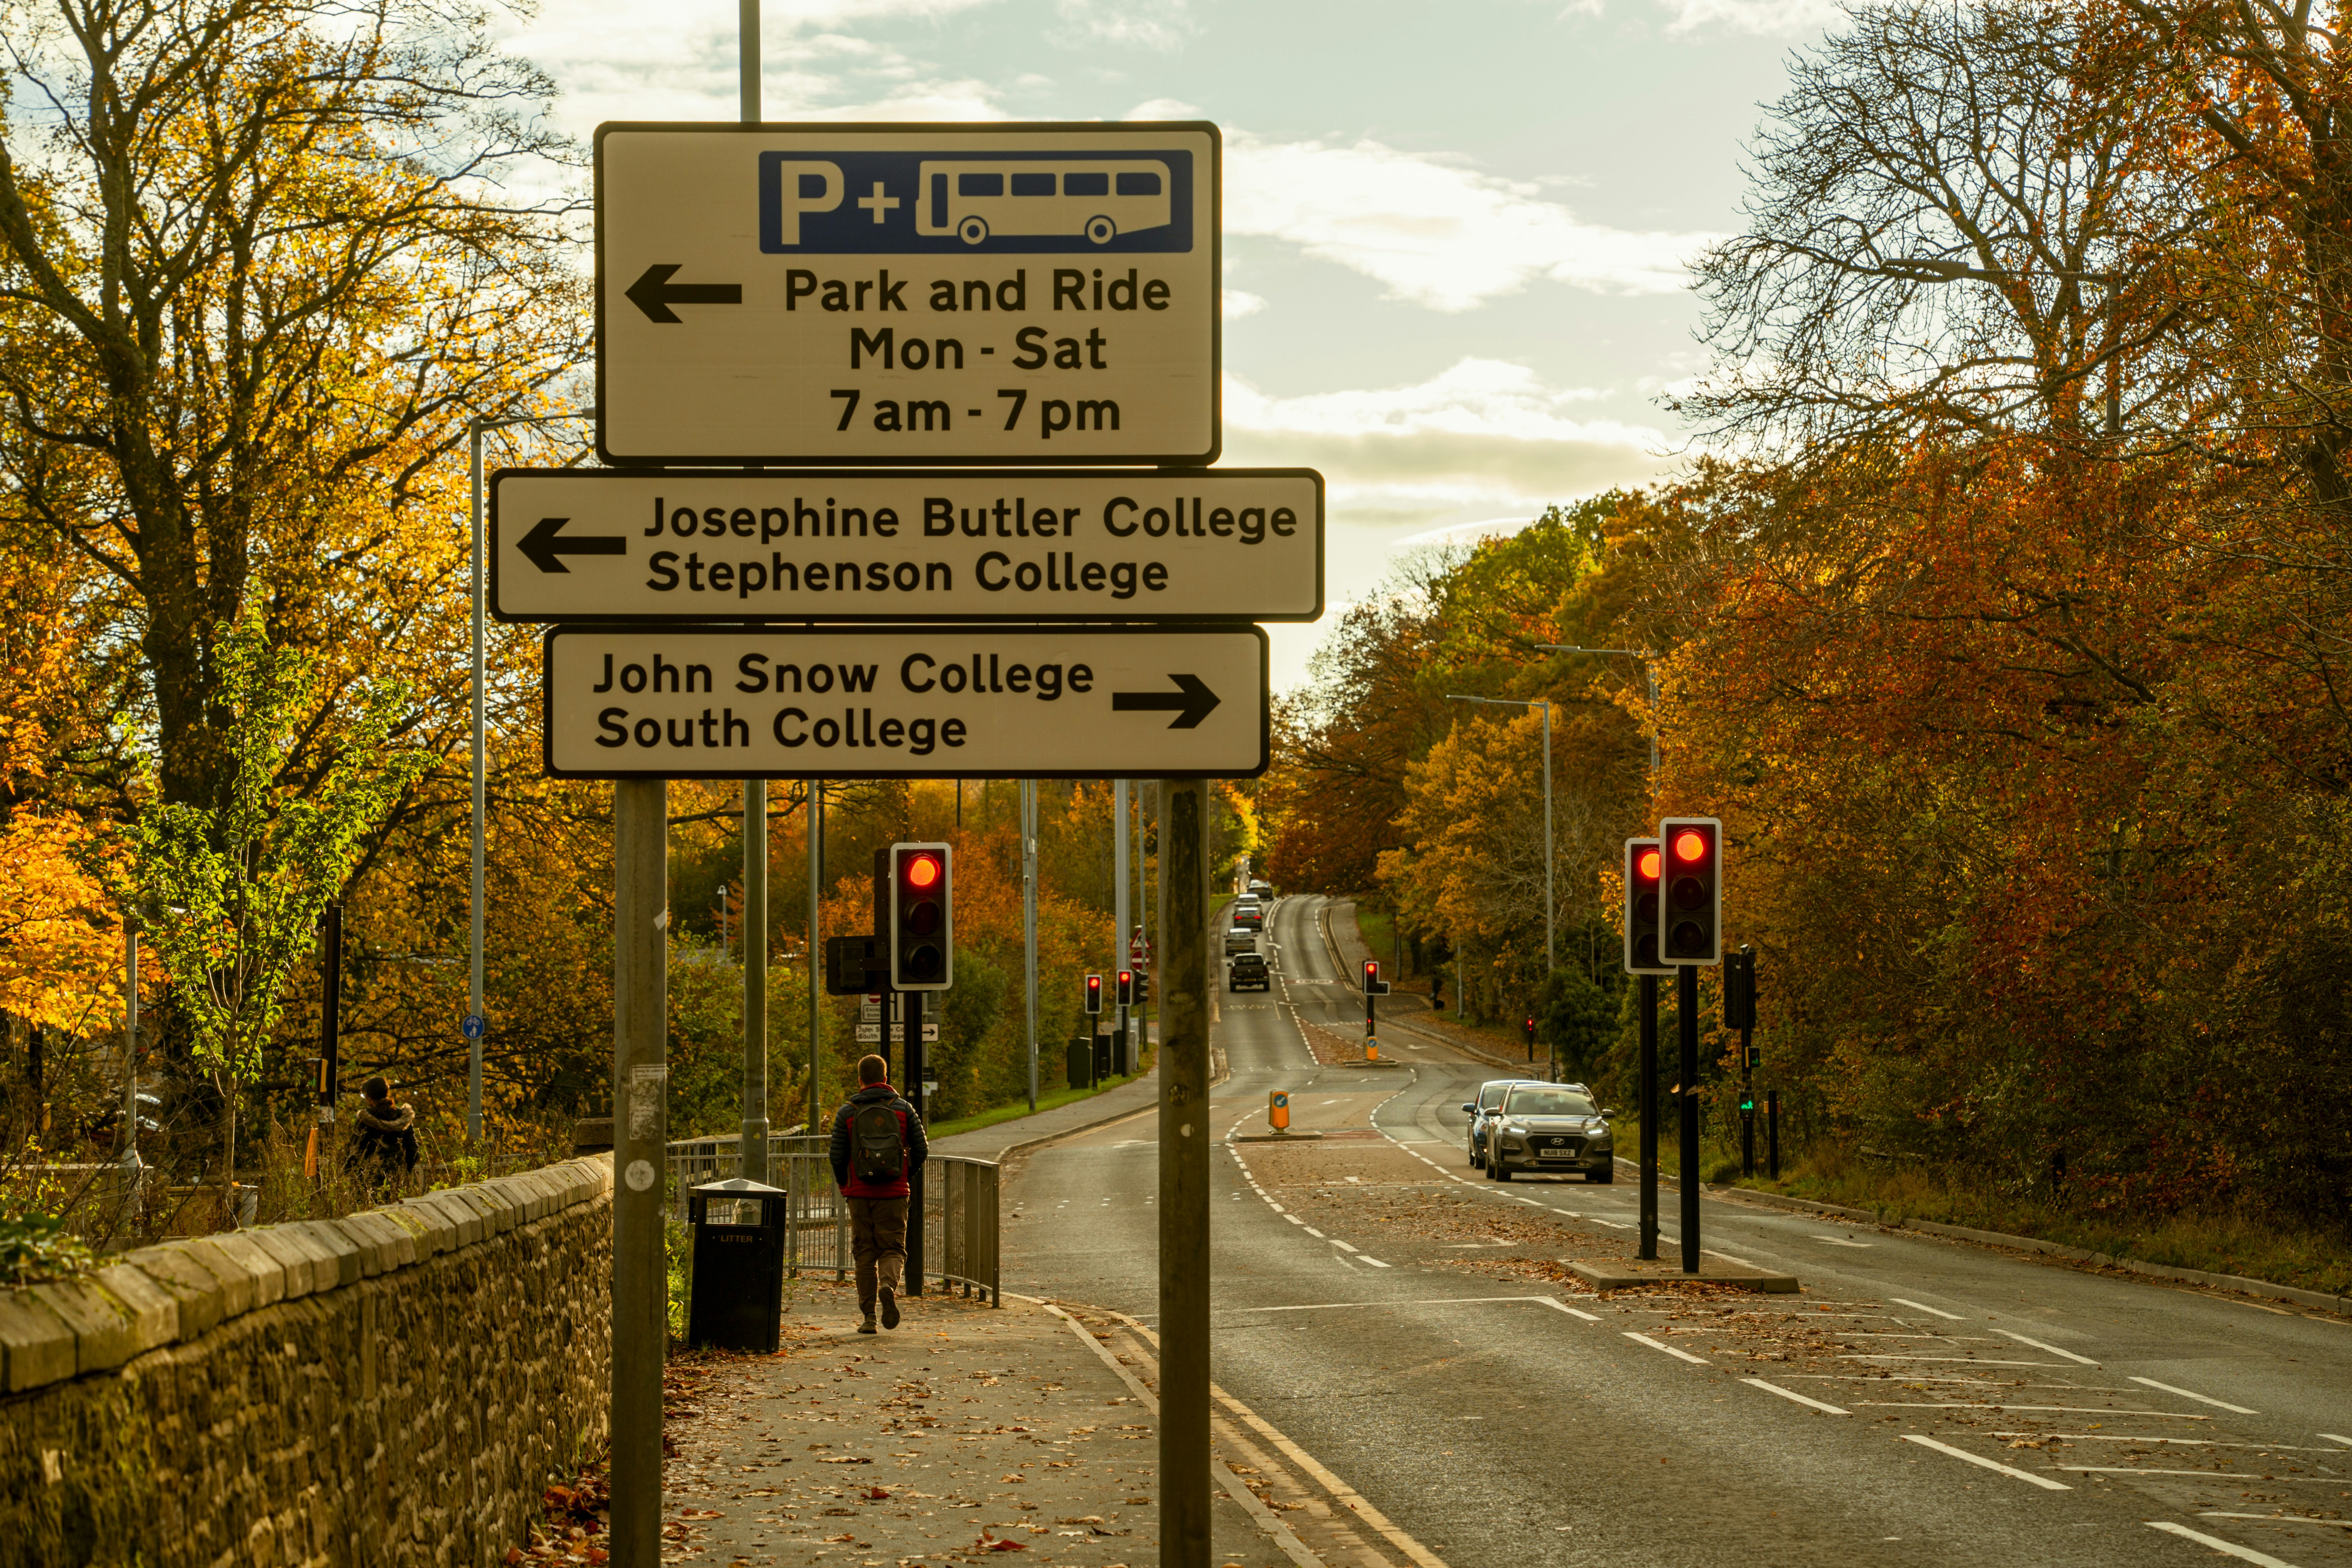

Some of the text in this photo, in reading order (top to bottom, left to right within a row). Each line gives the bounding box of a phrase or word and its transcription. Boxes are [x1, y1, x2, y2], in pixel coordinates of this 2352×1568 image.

[786, 269, 1170, 312] Park and Ride
[851, 328, 963, 370] Mon
[1012, 327, 1107, 370] Sat
[644, 497, 1296, 543] Josephine Butler College
[646, 551, 1168, 599] Stephenson College
[593, 653, 1093, 701] John Snow College
[595, 708, 966, 755] South College
